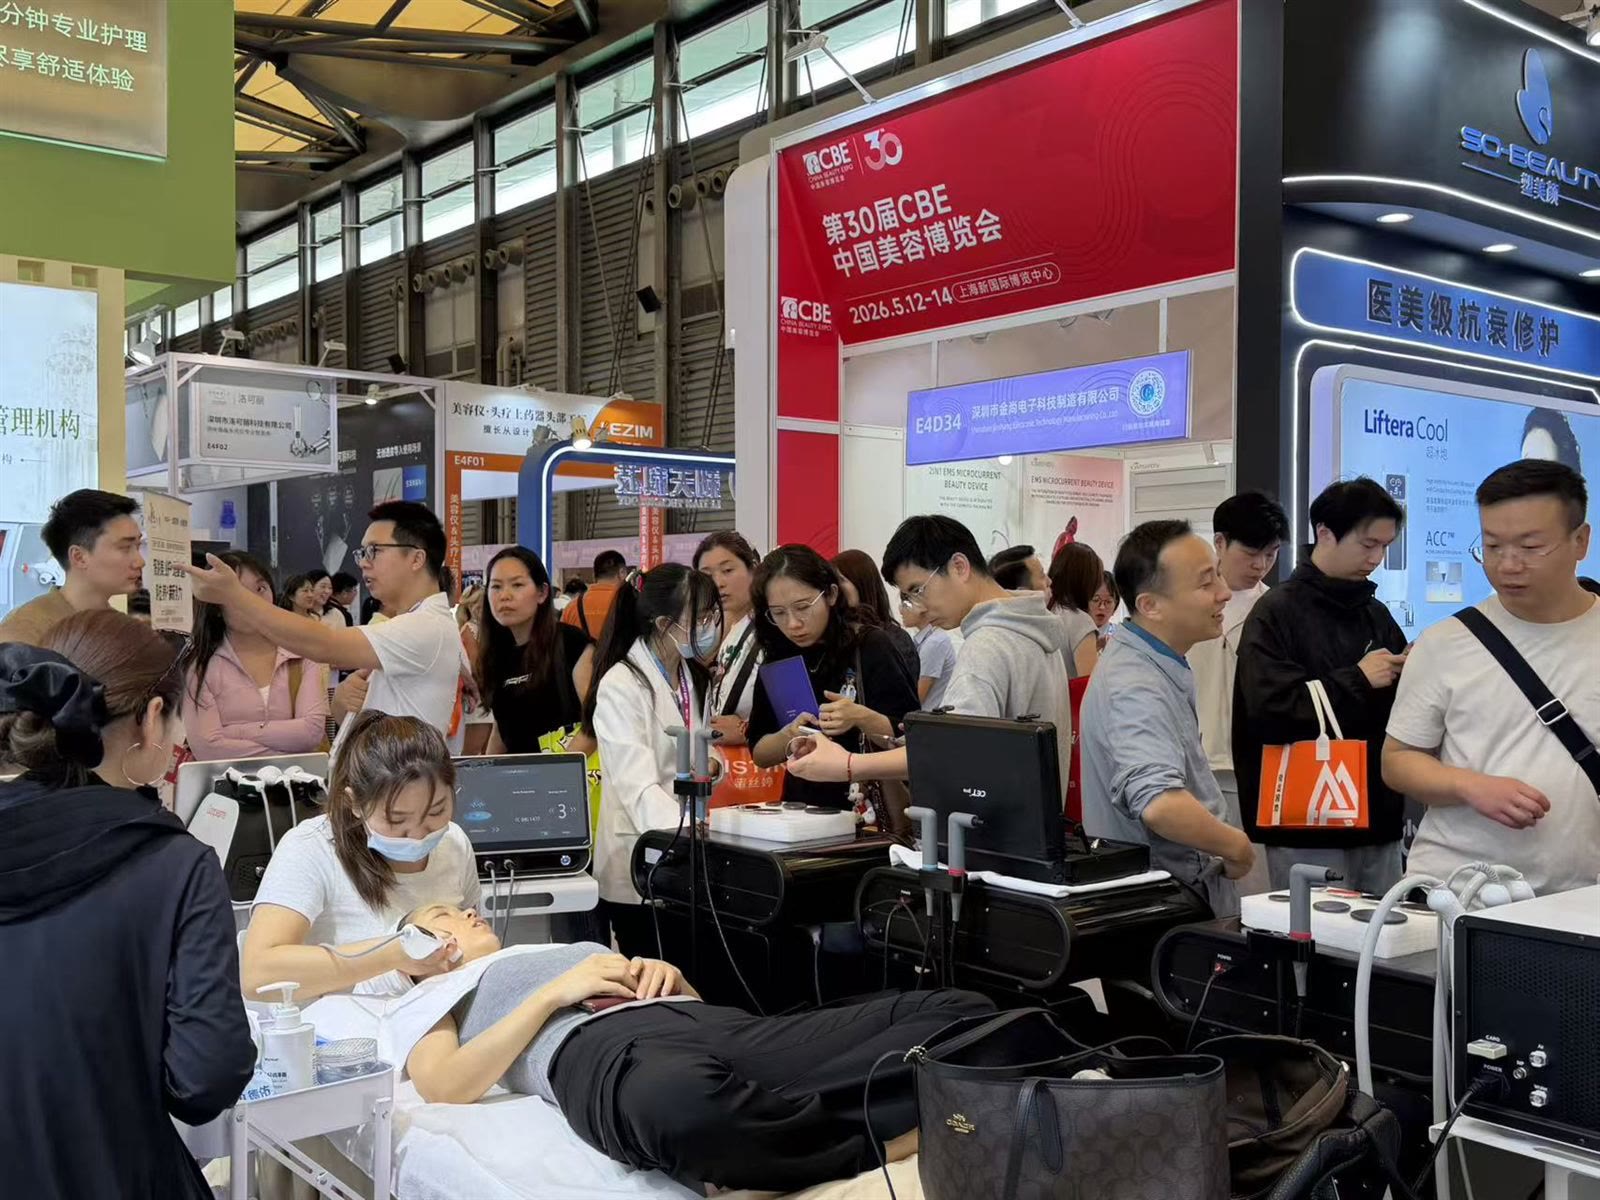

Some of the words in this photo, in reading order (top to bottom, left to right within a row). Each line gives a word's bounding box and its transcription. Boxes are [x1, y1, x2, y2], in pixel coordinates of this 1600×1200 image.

[819, 142, 851, 170] CBE
[864, 128, 903, 171] 30
[822, 183, 952, 246] 第30届CBE
[833, 208, 1003, 278] 中国美容博览会
[849, 286, 953, 325] 2026.5.12-14
[959, 266, 1054, 299] 上海新国际博览中心
[798, 300, 832, 324] CBE
[1367, 278, 1560, 358] 医美级抗衰修护
[915, 413, 962, 435] E4D34
[1364, 409, 1414, 438] Liftera
[1416, 416, 1448, 442] Cool
[454, 455, 485, 466] E4F01
[943, 467, 955, 477] EMS
[956, 468, 1001, 480] MICROCURRENT
[1031, 475, 1042, 483] EMS
[1043, 476, 1080, 487] MICROCURRENT
[1081, 479, 1097, 487] BEAUTY
[1098, 480, 1114, 489] DEVICE
[944, 480, 966, 489] BEAUTY
[967, 481, 988, 491] DEVICE
[558, 803, 567, 819] 3
[1483, 1064, 1503, 1073] POWER
